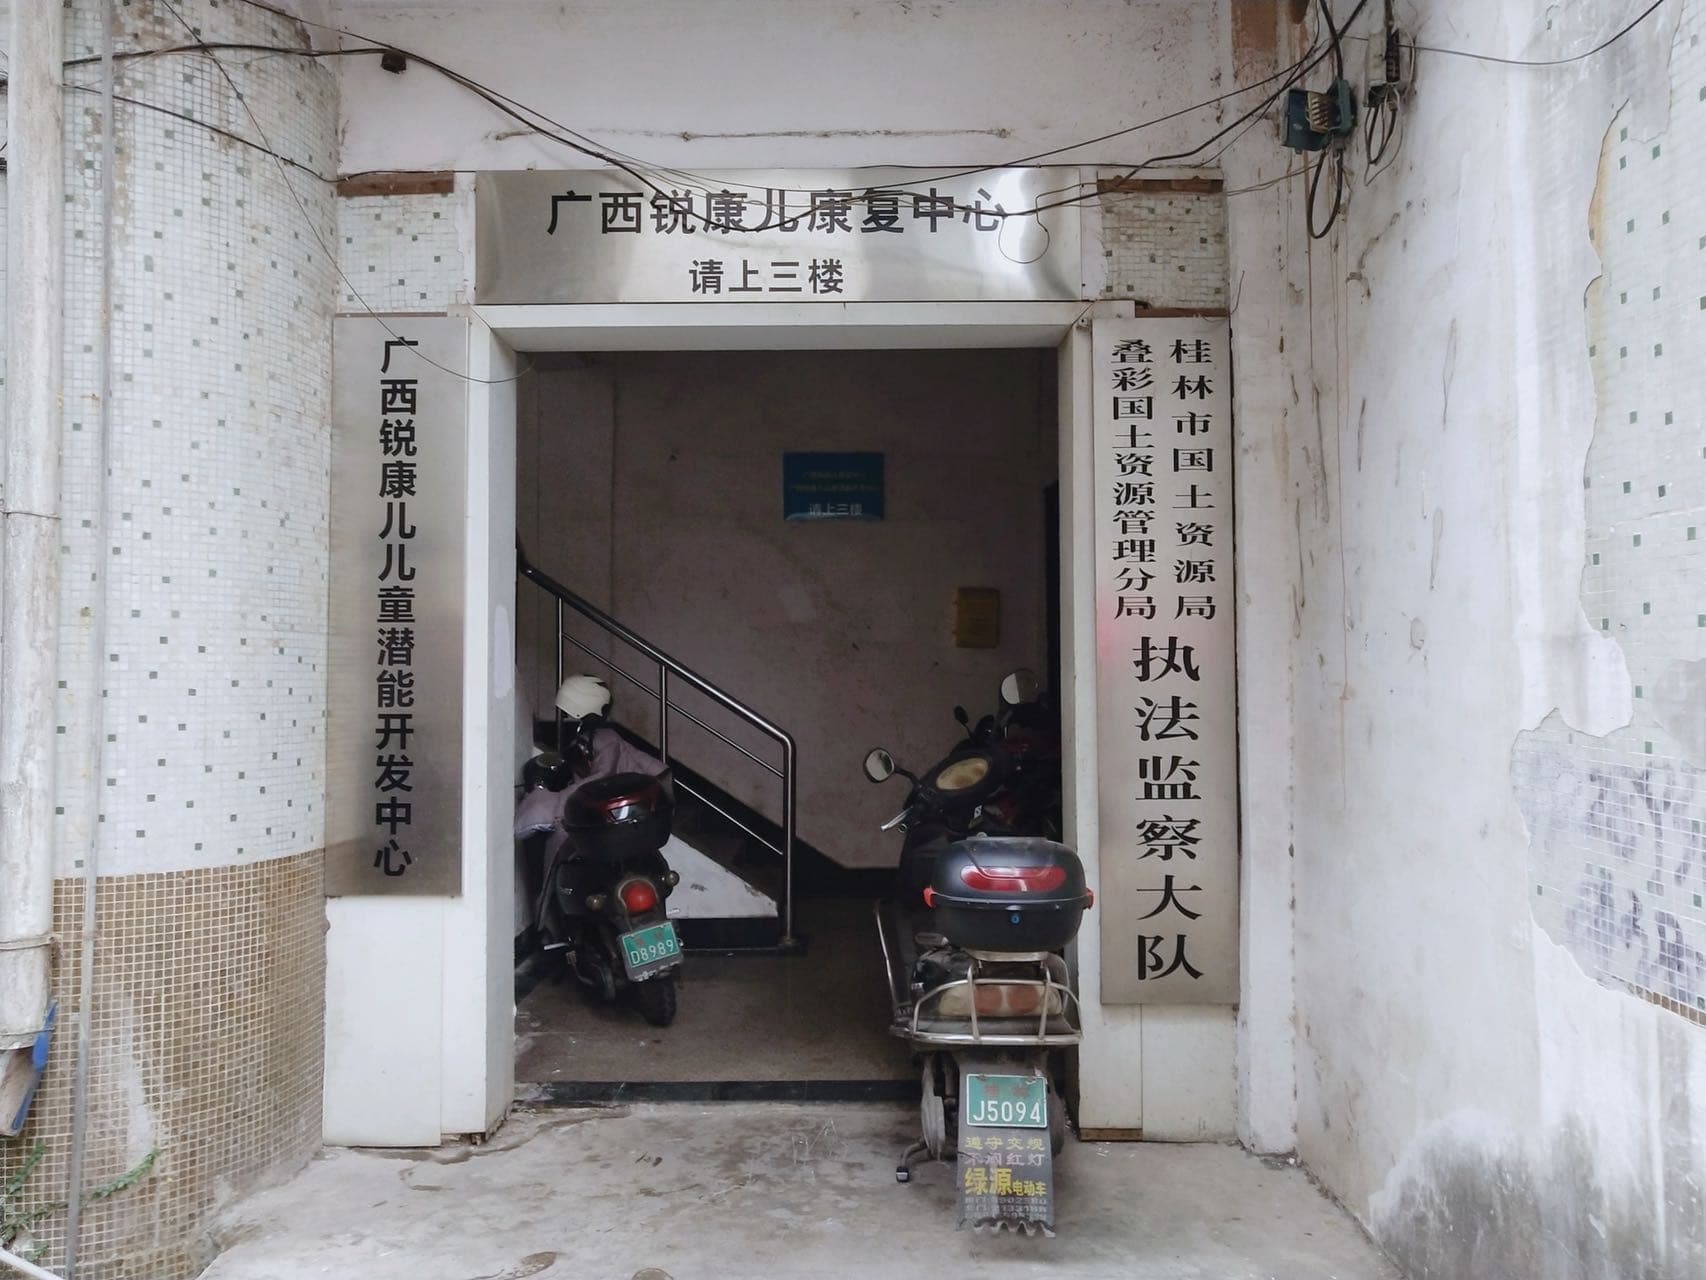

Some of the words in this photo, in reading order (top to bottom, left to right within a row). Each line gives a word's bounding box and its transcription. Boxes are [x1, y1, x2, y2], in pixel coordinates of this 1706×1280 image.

[546, 189, 1006, 235] 广西锐康儿康复中心
[689, 259, 845, 295] 请上三楼
[1111, 338, 1156, 621] 叠彩国土资源管理分局
[1169, 338, 1217, 621] 桂林市国土资源局
[373, 336, 419, 878] 广西锐康儿儿童潜能开发中心
[1132, 635, 1204, 981] 执法监察大队
[630, 939, 674, 964] D8989
[972, 1100, 1041, 1123] J5094
